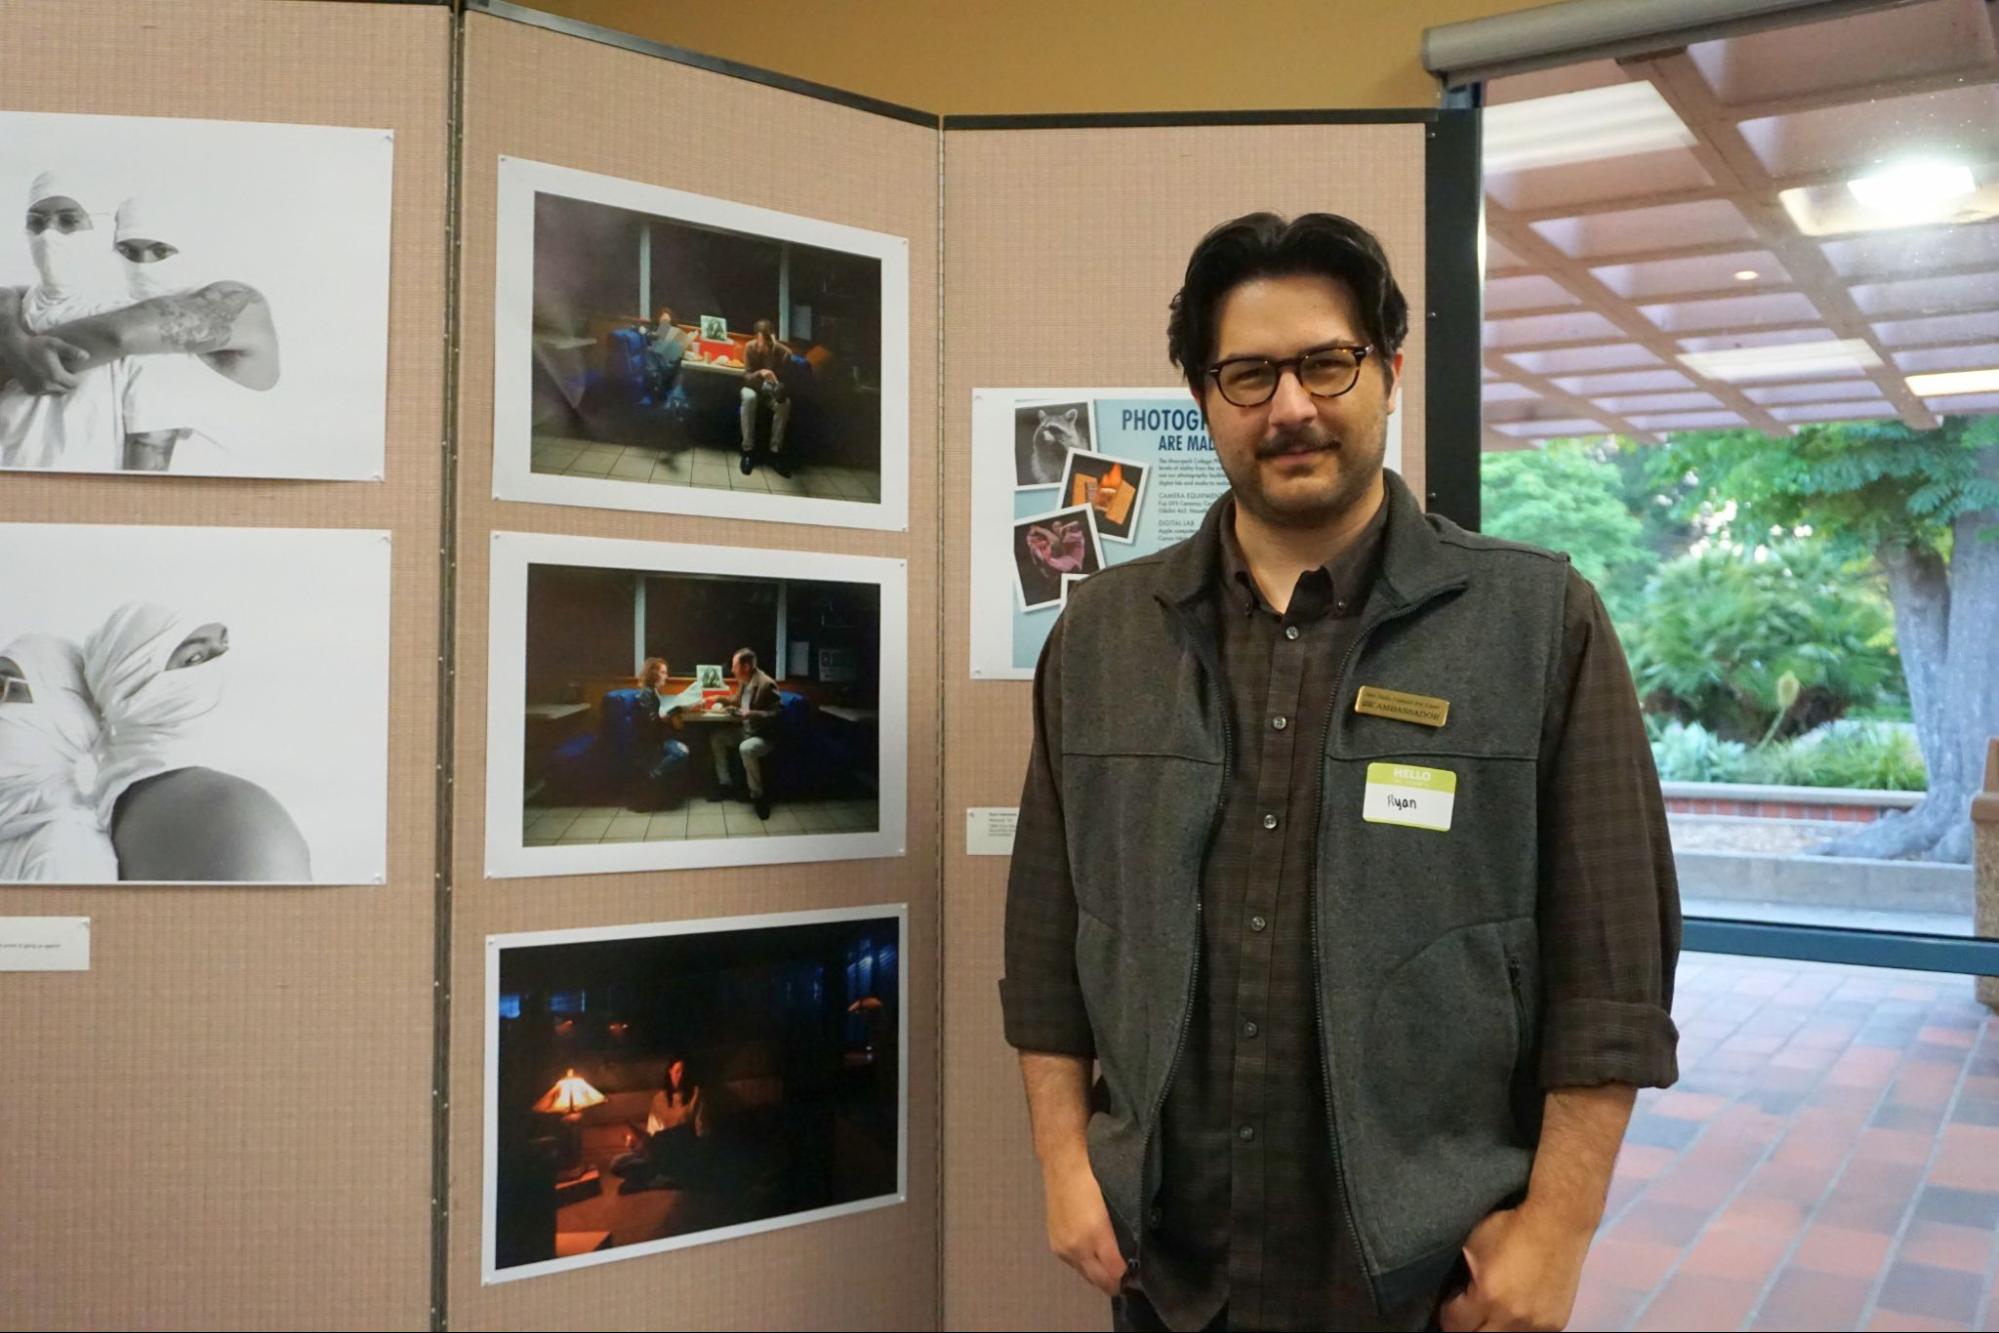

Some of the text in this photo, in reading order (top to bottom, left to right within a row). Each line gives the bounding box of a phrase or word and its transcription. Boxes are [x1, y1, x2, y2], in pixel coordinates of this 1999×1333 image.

[1158, 435, 1183, 451] ARE
[1376, 703, 1440, 720] AMBASSADOR
[1392, 768, 1431, 782] HELLO
[1387, 793, 1417, 811] Ryan
